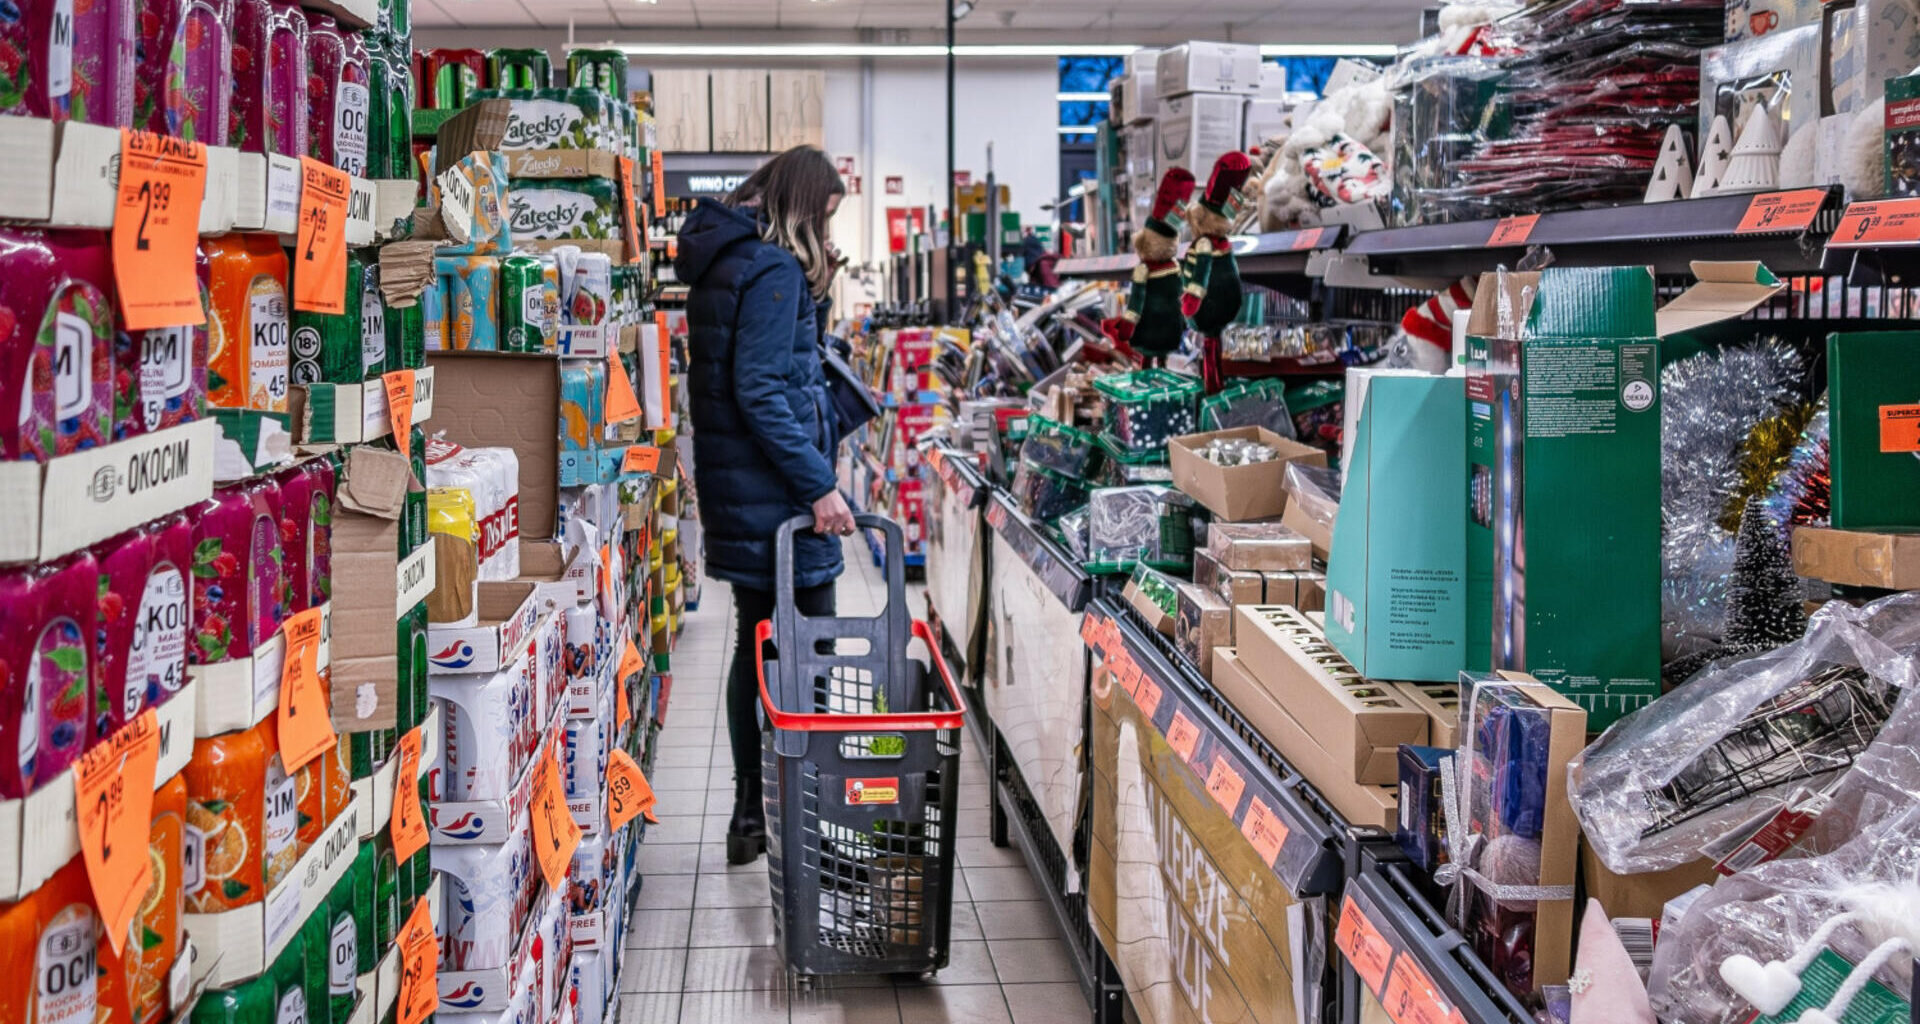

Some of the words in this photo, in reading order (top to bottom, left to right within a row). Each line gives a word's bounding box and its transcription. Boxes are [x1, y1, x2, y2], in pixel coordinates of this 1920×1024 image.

[688, 176, 723, 192] WINO
[136, 180, 151, 251] 2
[154, 182, 171, 210] 99
[1853, 216, 1871, 241] 9
[298, 336, 318, 350] 18+
[574, 330, 598, 339] FREE
[127, 438, 190, 495] OKOCIM
[570, 686, 591, 696] REE
[614, 775, 631, 795] 59
[610, 786, 623, 814] 3
[570, 918, 597, 929] FREE
